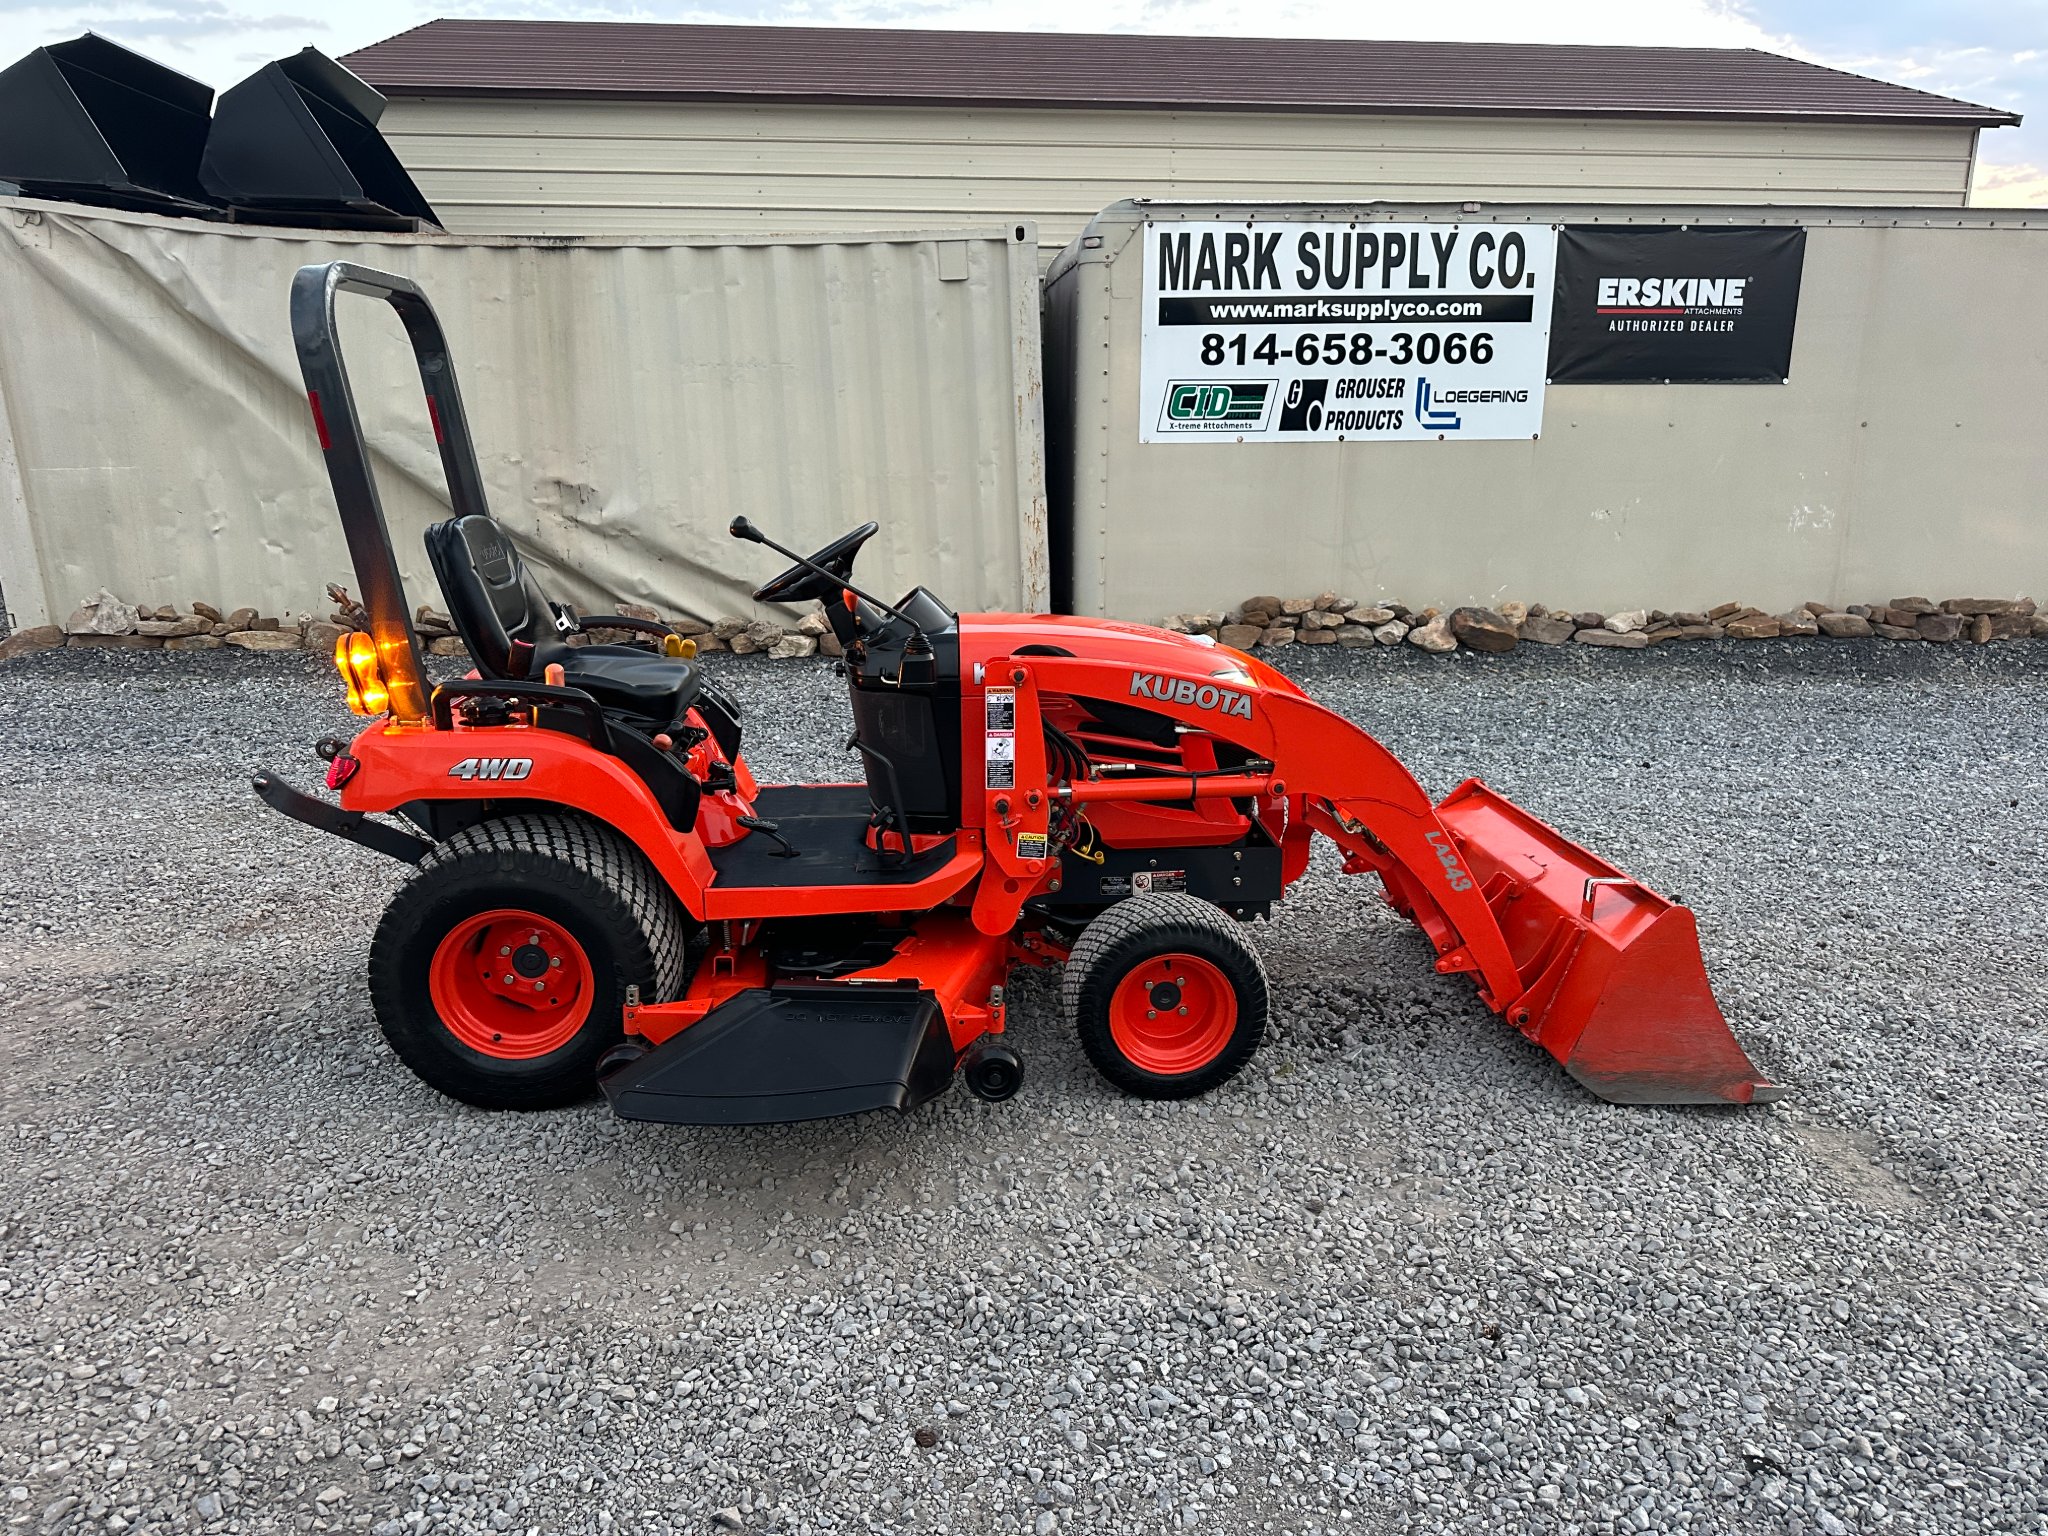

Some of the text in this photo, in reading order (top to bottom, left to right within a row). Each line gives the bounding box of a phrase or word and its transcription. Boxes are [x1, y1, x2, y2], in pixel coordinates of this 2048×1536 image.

[1159, 231, 1535, 290] MARK SUPPLY CO.
[1597, 278, 1746, 307] ERSKINE
[1210, 299, 1483, 321] www.marksupplyco.com
[1609, 320, 1734, 332] AUTHORIZED DEALER
[1200, 333, 1494, 366] 814-658-3066
[1336, 378, 1405, 399] GROUSER
[1434, 390, 1528, 403] LOEGERING
[1170, 386, 1233, 419] CID
[1169, 422, 1253, 430] X-treme Attachments
[1325, 410, 1404, 431] PRODUCTS
[1129, 671, 1252, 720] KUBOTA
[448, 757, 534, 780] 4WD
[1424, 831, 1473, 892] LA243
